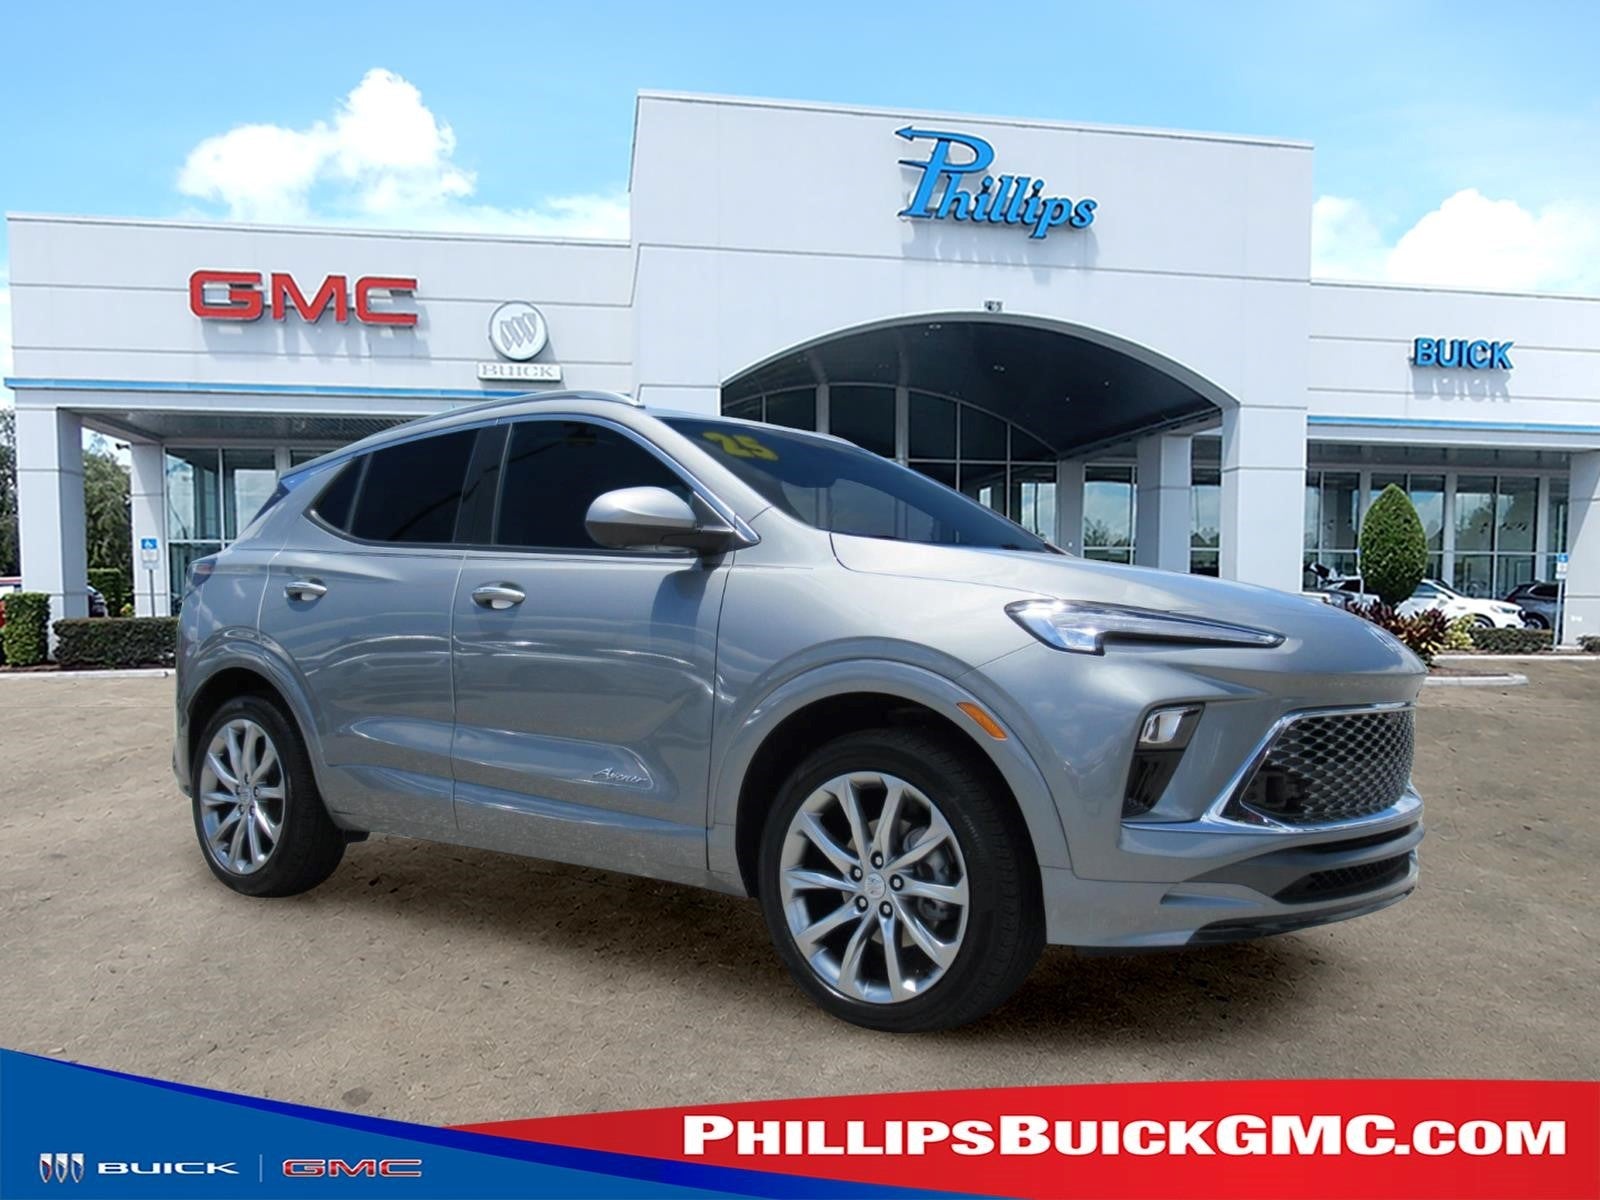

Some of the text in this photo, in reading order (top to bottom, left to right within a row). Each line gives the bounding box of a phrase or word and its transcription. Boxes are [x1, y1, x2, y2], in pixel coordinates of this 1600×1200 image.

[895, 126, 1098, 239] Phillips
[190, 270, 418, 326] GMC
[1412, 338, 1514, 369] BUICK
[482, 364, 554, 378] BUICK
[702, 431, 779, 460] 25
